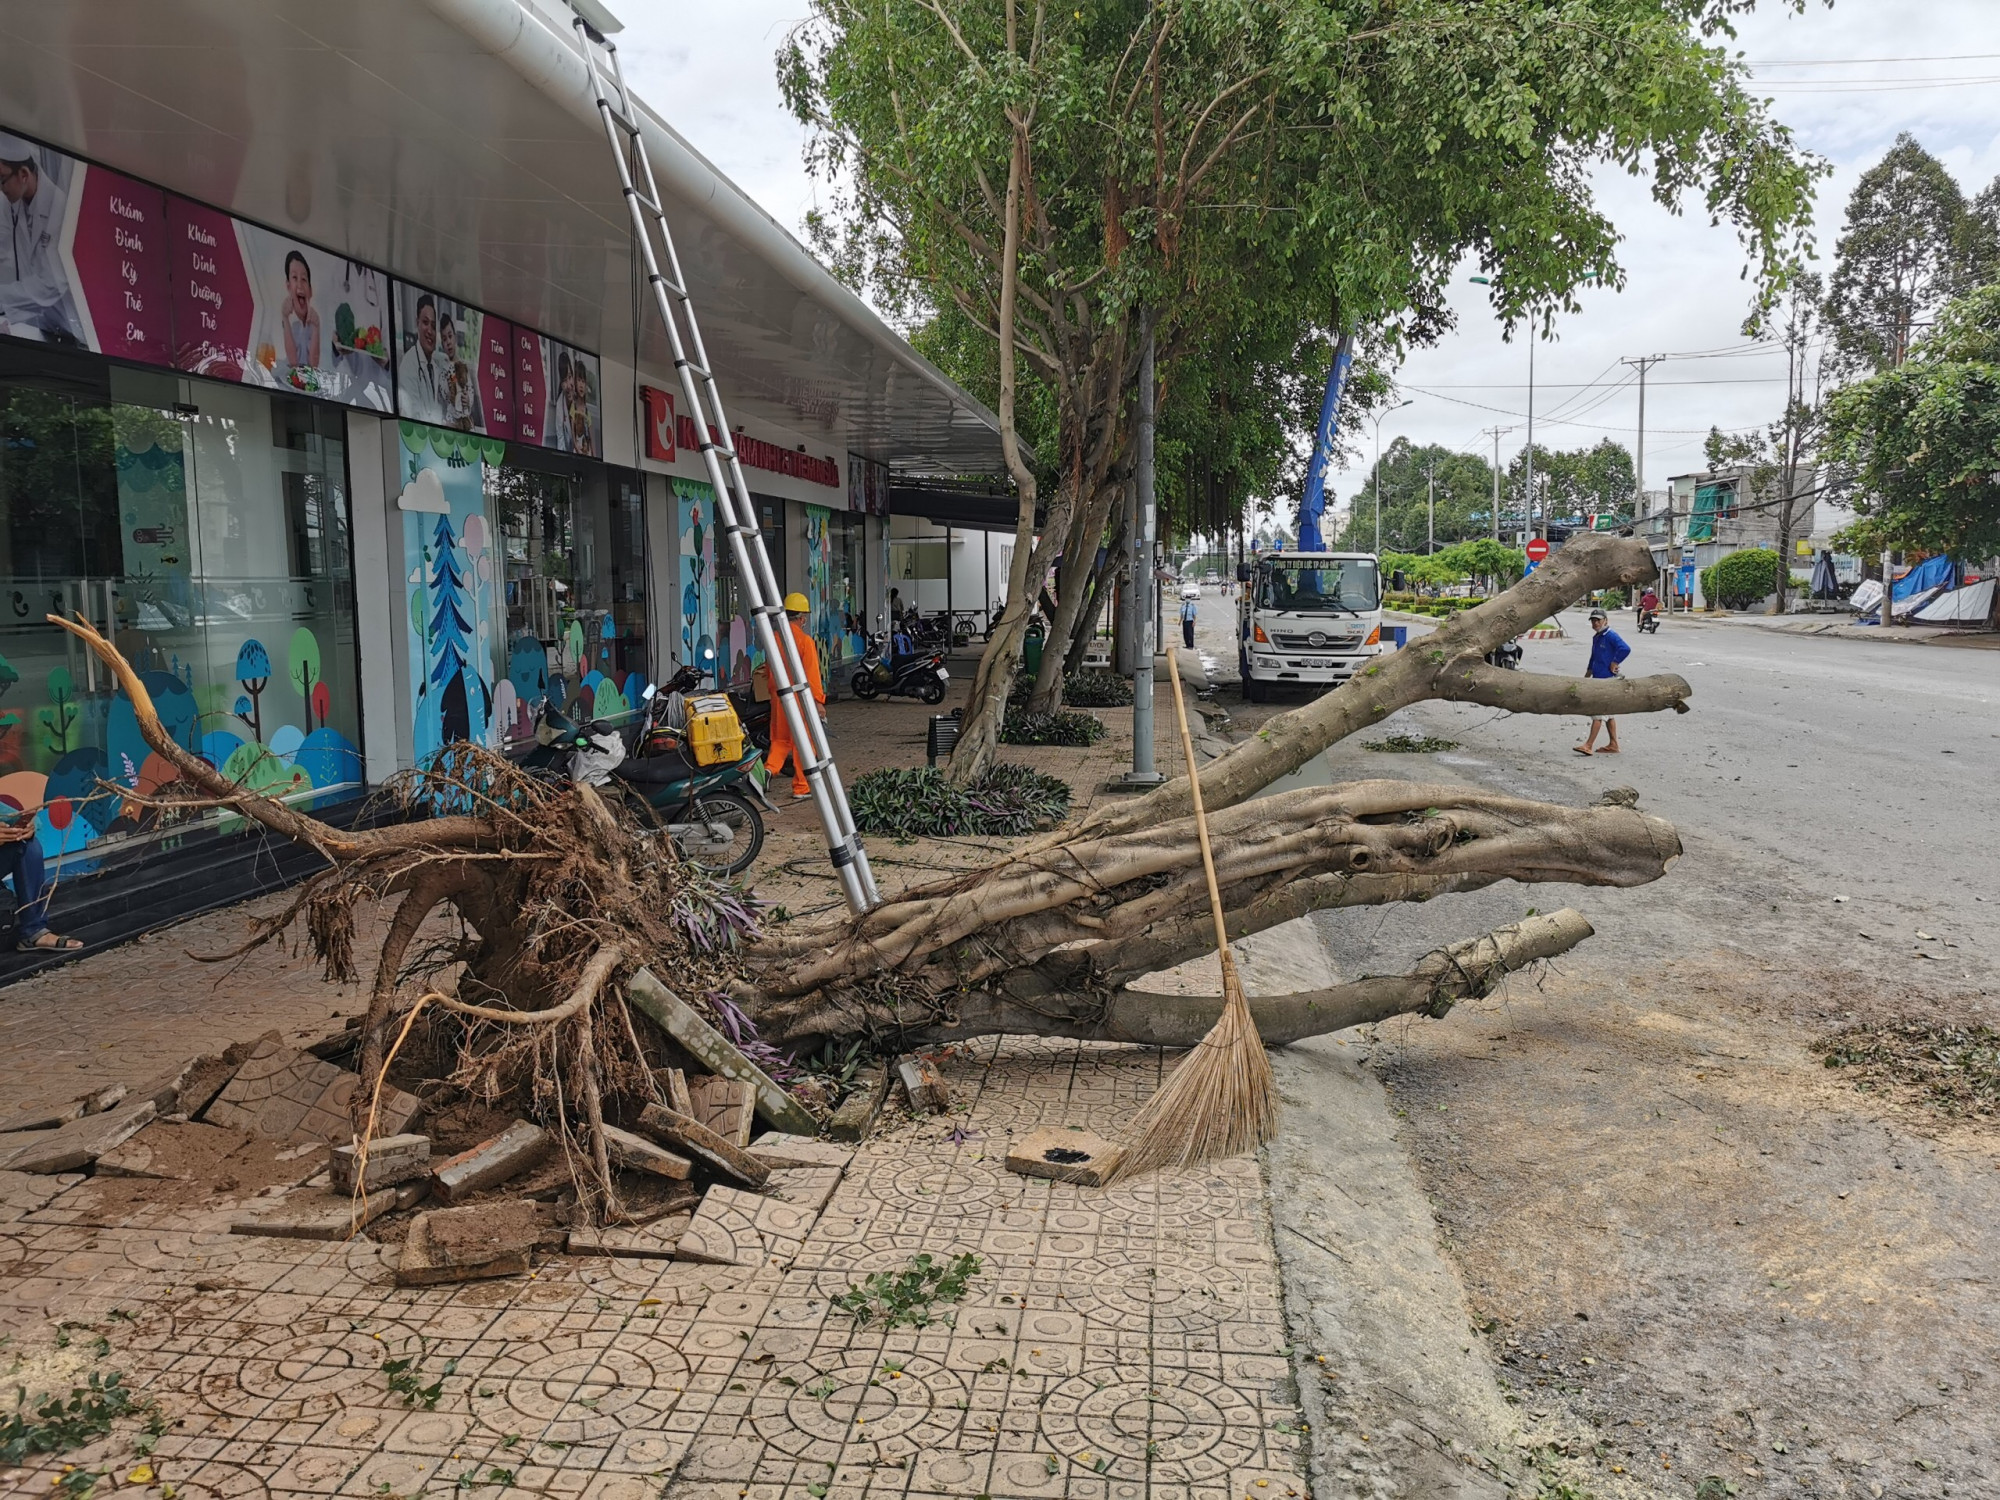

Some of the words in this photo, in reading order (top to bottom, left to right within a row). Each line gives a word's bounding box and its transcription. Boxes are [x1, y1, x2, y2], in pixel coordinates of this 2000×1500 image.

[110, 195, 144, 223] Khám
[115, 227, 143, 253] Định
[188, 223, 217, 247] Khám
[122, 260, 138, 285] Kỳ
[193, 252, 217, 275] Dinh
[124, 291, 143, 312] Trẻ
[191, 280, 223, 310] Dưỡng
[126, 322, 145, 341] Em
[201, 311, 217, 331] Trẻ
[202, 340, 217, 358] Em
